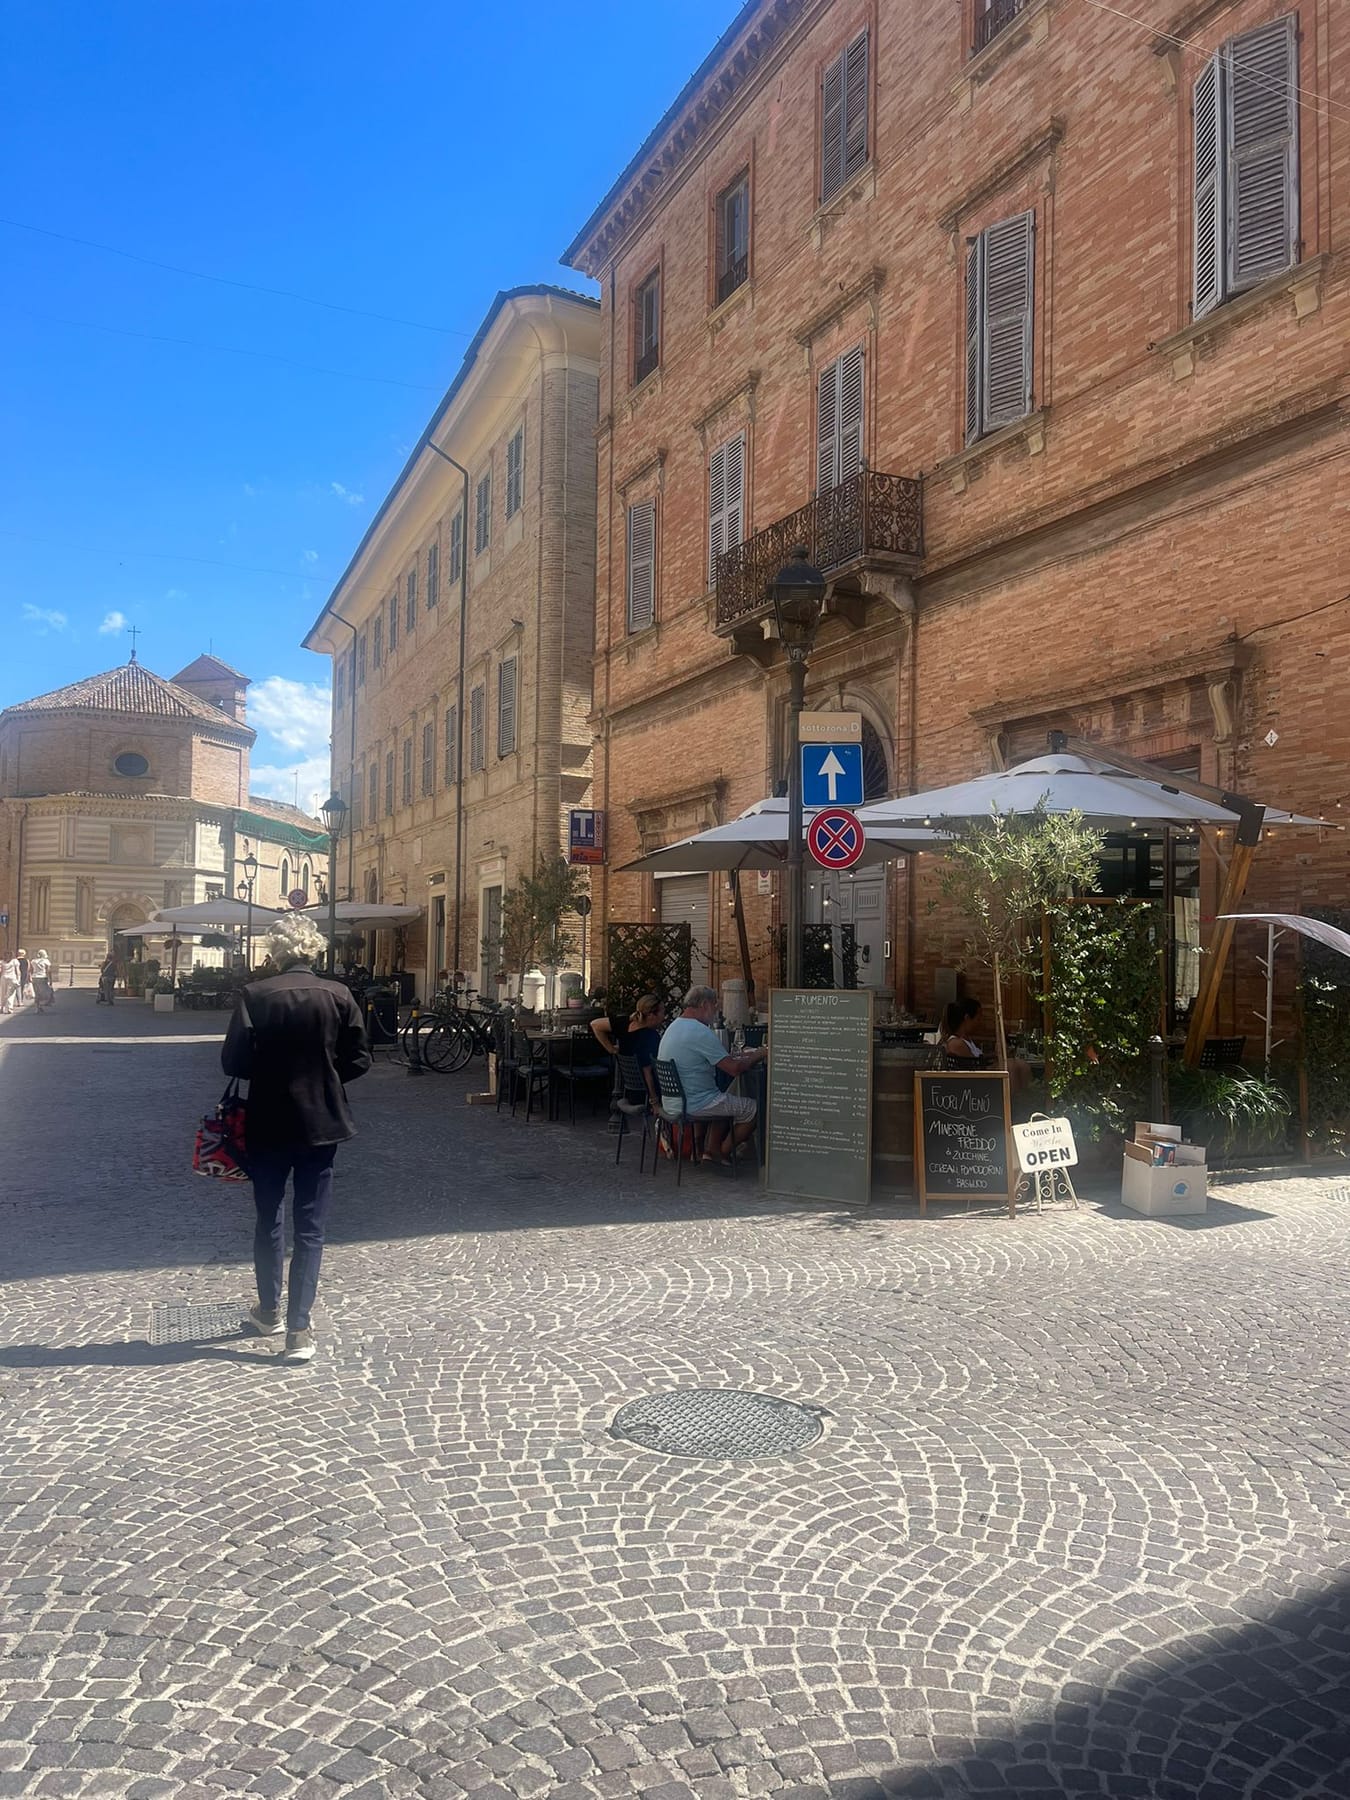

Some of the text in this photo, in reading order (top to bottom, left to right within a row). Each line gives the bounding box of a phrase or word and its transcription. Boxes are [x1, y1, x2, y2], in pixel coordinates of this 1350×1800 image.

[850, 722, 860, 732] D
[574, 812, 593, 837] T
[794, 995, 839, 1006] FRUMENTO
[931, 1086, 957, 1110] FUORI
[929, 1120, 977, 1137] MINESTRONE
[1022, 1125, 1062, 1138] Come In
[958, 1137, 996, 1151] FREDDO
[1026, 1147, 1071, 1166] OPEN
